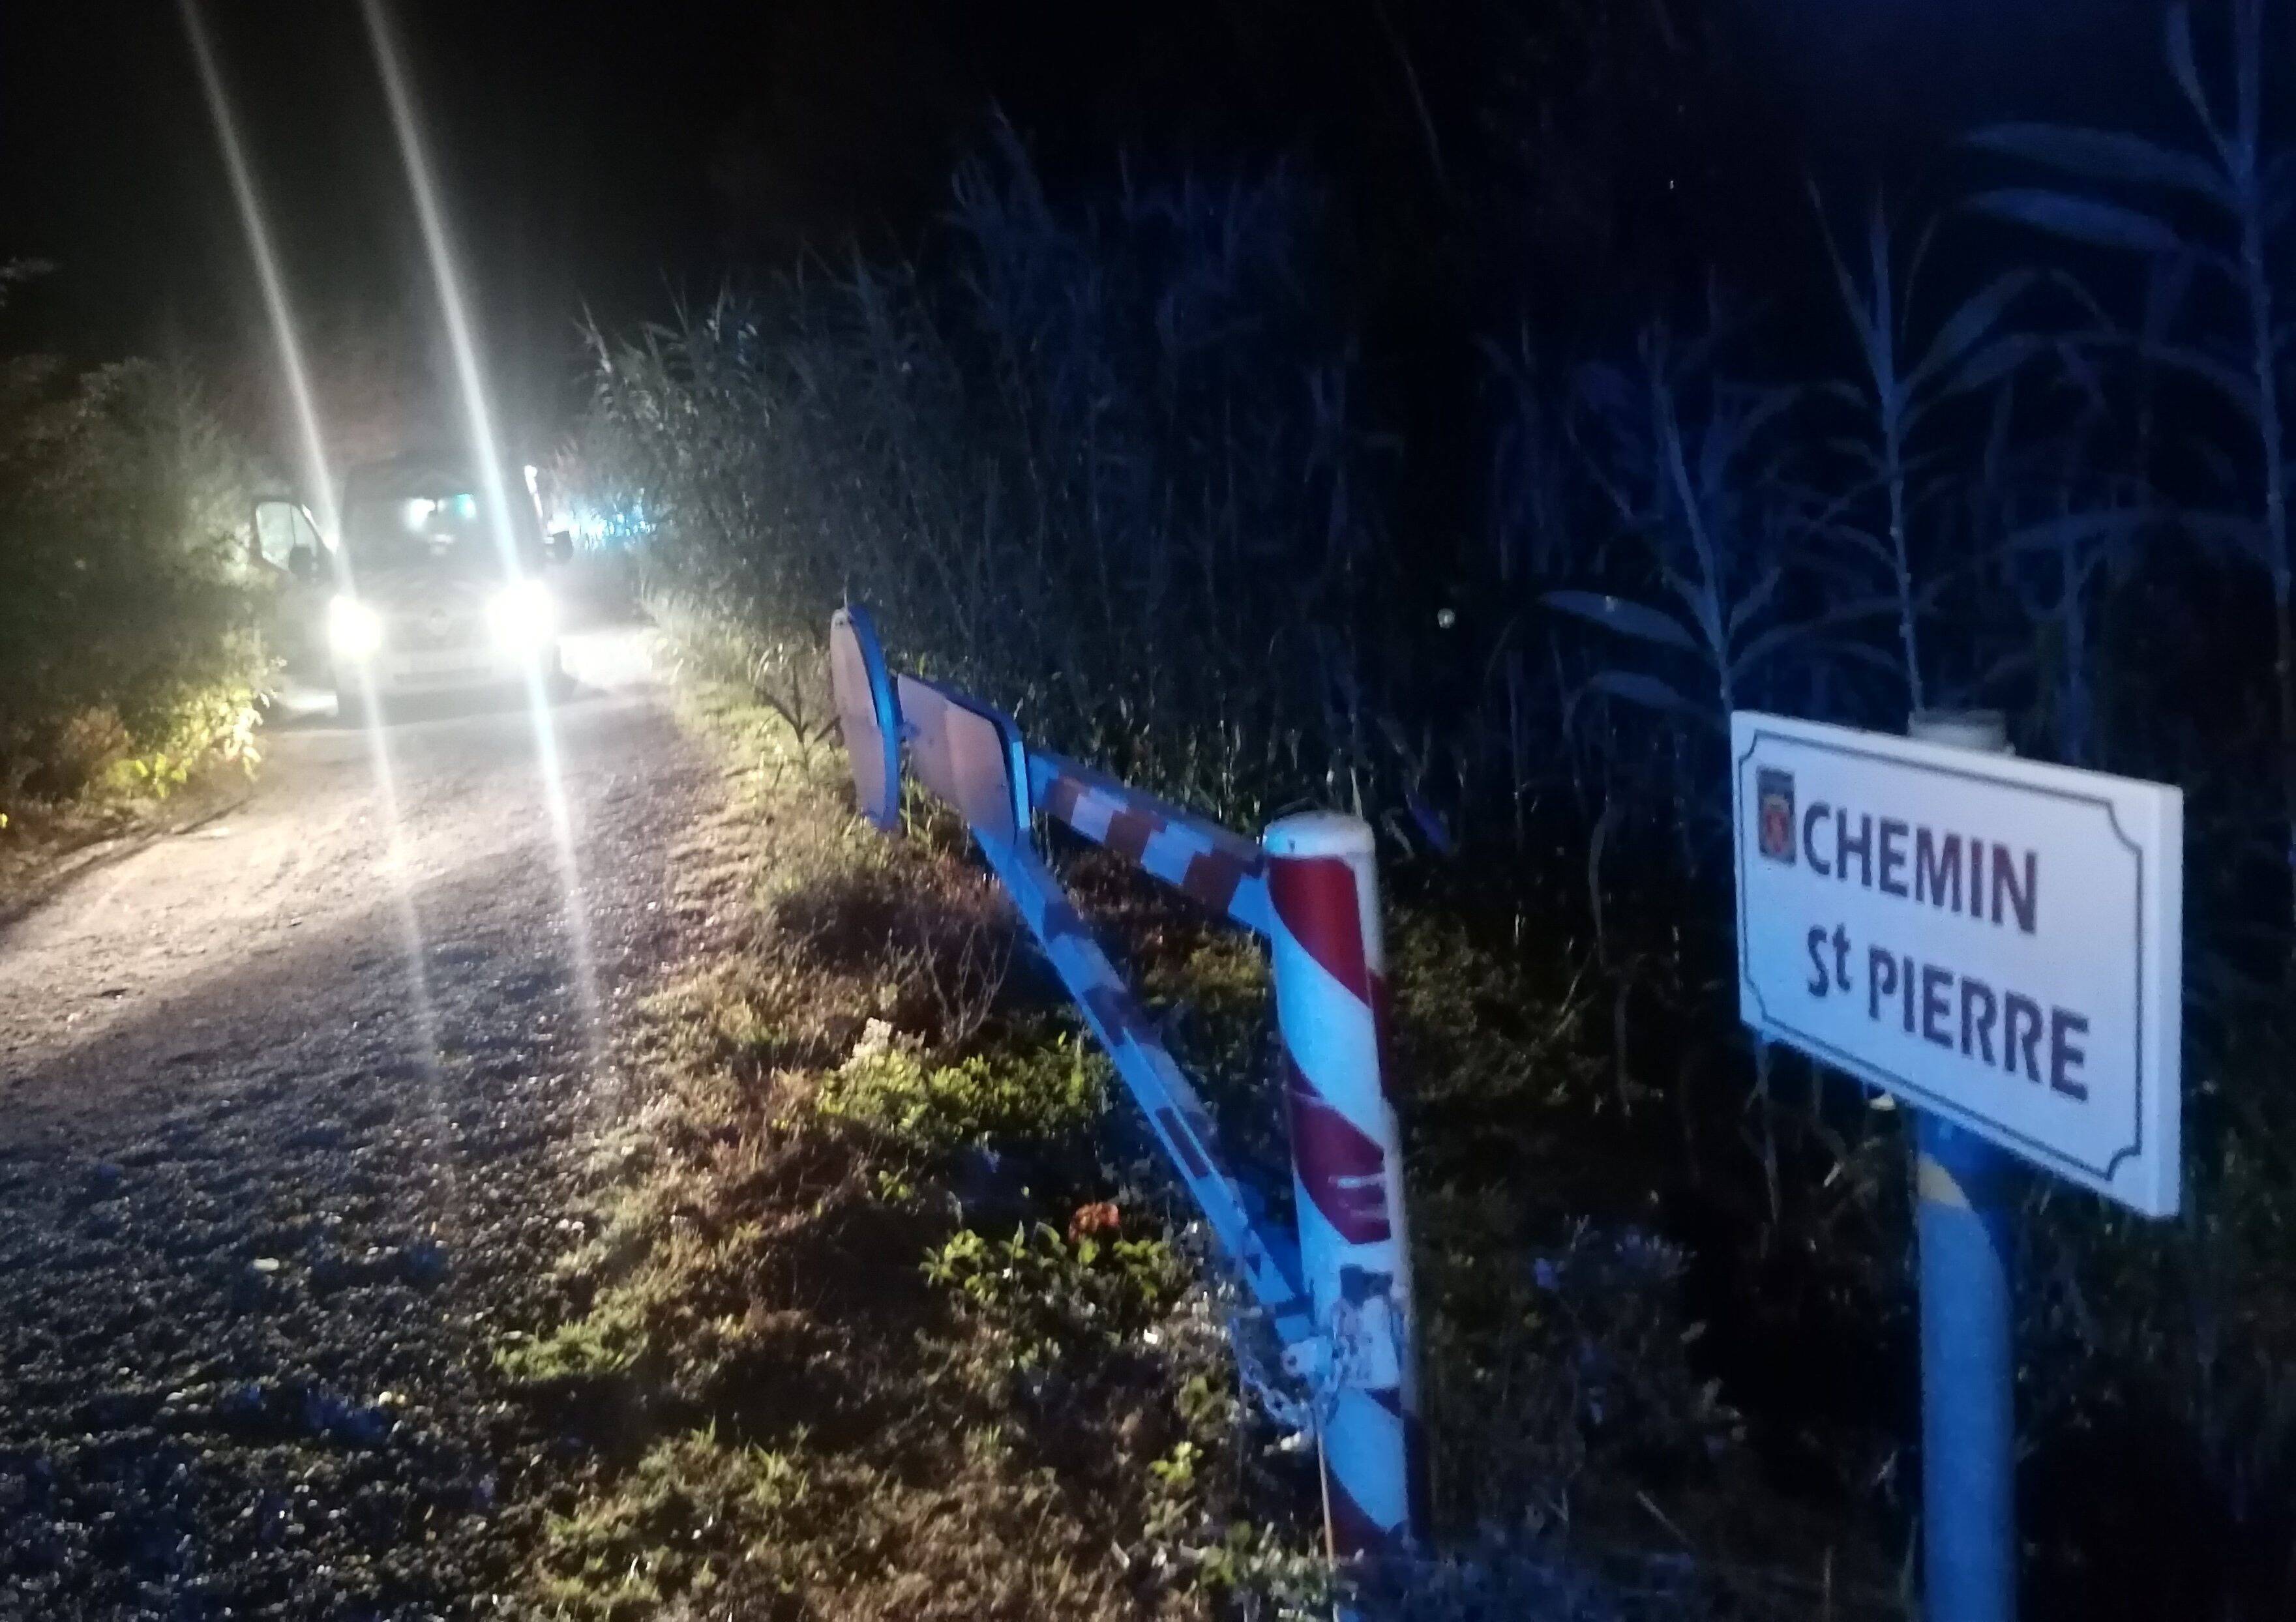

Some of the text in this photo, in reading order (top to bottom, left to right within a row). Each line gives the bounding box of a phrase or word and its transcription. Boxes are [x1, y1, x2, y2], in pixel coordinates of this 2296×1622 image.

[1804, 801, 2038, 935] CHEMIN
[1807, 923, 2090, 1102] St PIERRE
